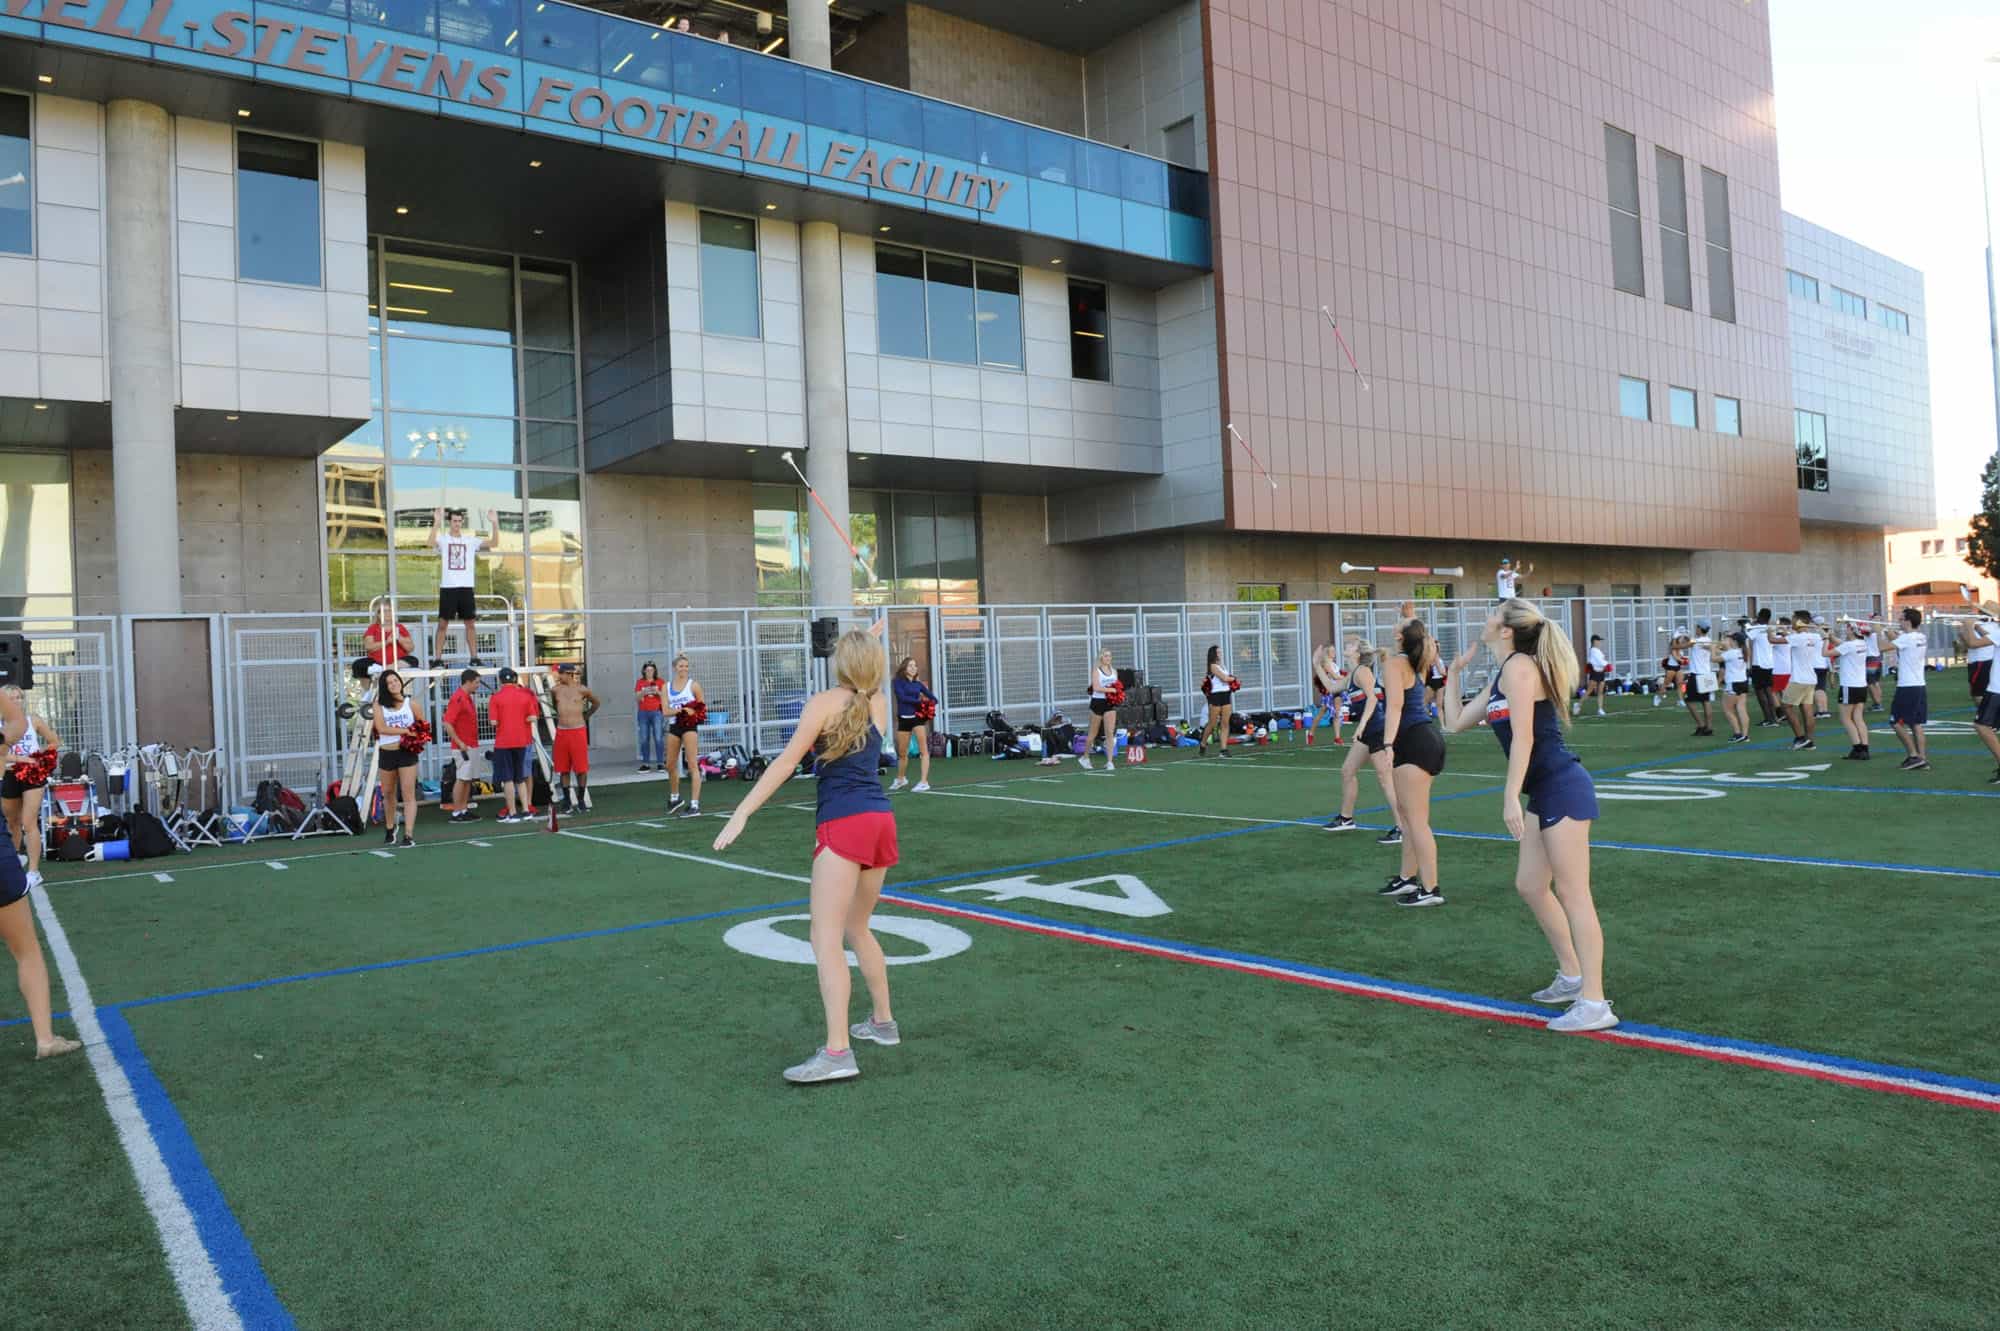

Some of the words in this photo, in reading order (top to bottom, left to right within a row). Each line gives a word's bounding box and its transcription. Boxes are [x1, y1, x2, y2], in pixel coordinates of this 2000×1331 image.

[527, 76, 806, 170] FOOTBALL
[821, 140, 1010, 214] FACILITY
[1127, 746, 1145, 763] 40
